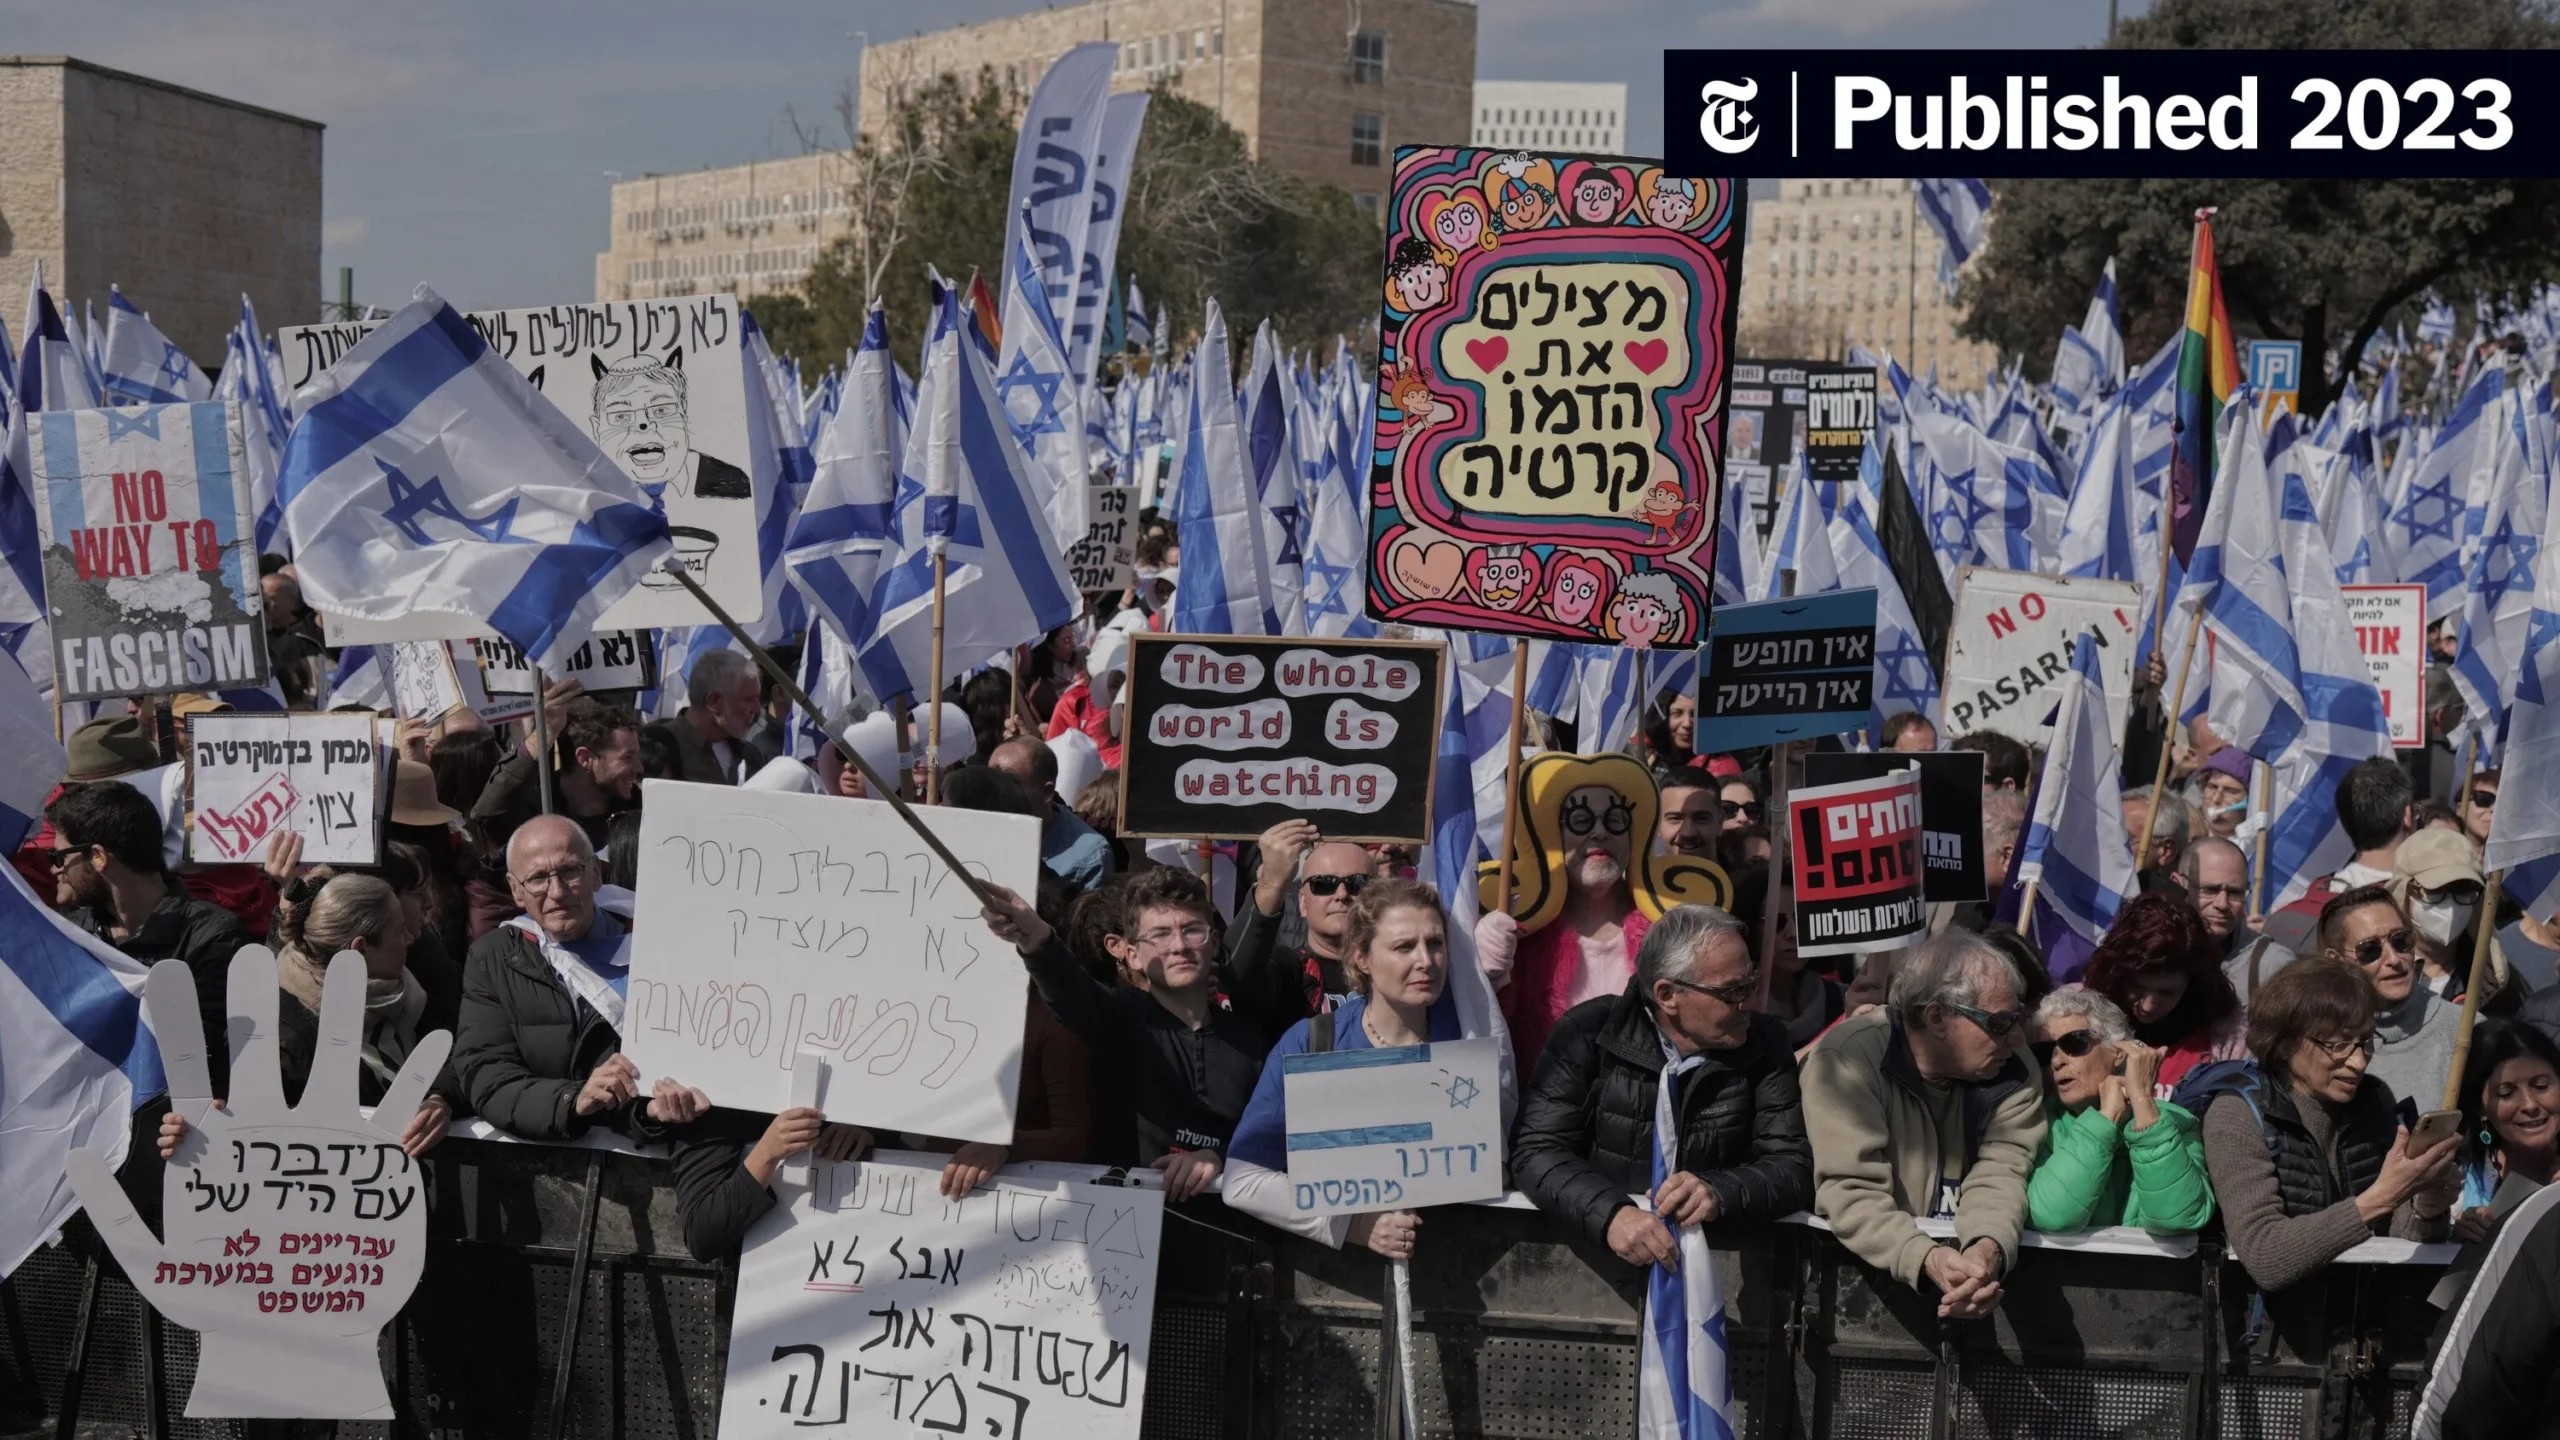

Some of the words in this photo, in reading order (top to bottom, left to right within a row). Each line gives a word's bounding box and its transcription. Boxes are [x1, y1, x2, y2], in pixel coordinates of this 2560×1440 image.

[1479, 270, 1668, 332] מצילים
[690, 296, 728, 354] לא
[1525, 338, 1612, 377] את
[1461, 441, 1650, 512] קרטיה
[112, 469, 167, 524] NO
[70, 524, 153, 582] WAY
[168, 518, 220, 573] TO
[1985, 592, 2046, 640] NO
[2344, 597, 2365, 610] תק
[2366, 596, 2382, 607] לא
[61, 623, 257, 695] FASCISM
[602, 629, 635, 668] לא
[1733, 638, 1814, 668] חופש
[1823, 634, 1869, 666] אין
[1173, 653, 1246, 685] The
[1283, 657, 1408, 688] whole
[1716, 682, 1808, 714] הייטק
[1816, 679, 1861, 710] אין
[1157, 708, 1284, 741] world
[1334, 709, 1380, 742] is
[197, 739, 312, 772] בדמוקרטיה
[321, 739, 371, 775] מבחן
[1182, 766, 1378, 804] watching
[309, 790, 358, 845] ציון:
[662, 835, 763, 896] חיסור
[1809, 907, 1872, 940] השלטון
[1875, 896, 1917, 931] לאיכות
[727, 910, 869, 957] מוצדק
[924, 925, 980, 980] לא
[633, 979, 772, 1059] המאבק
[780, 992, 979, 1089] למען
[1395, 1141, 1488, 1179] ירדנו
[185, 1167, 251, 1213] שלי
[262, 1179, 337, 1213] היד
[353, 1185, 416, 1221] עם
[1294, 1178, 1404, 1211] מהפסים
[223, 1228, 262, 1257] לא
[280, 1232, 396, 1260] עבריינים
[808, 1235, 865, 1284] לא
[889, 1236, 964, 1286] אבל
[154, 1260, 275, 1286] במערכת
[291, 1263, 384, 1286] נוגעים
[257, 1289, 366, 1315] המשפט
[859, 1300, 935, 1352] את
[949, 1313, 1130, 1408] מפסידה
